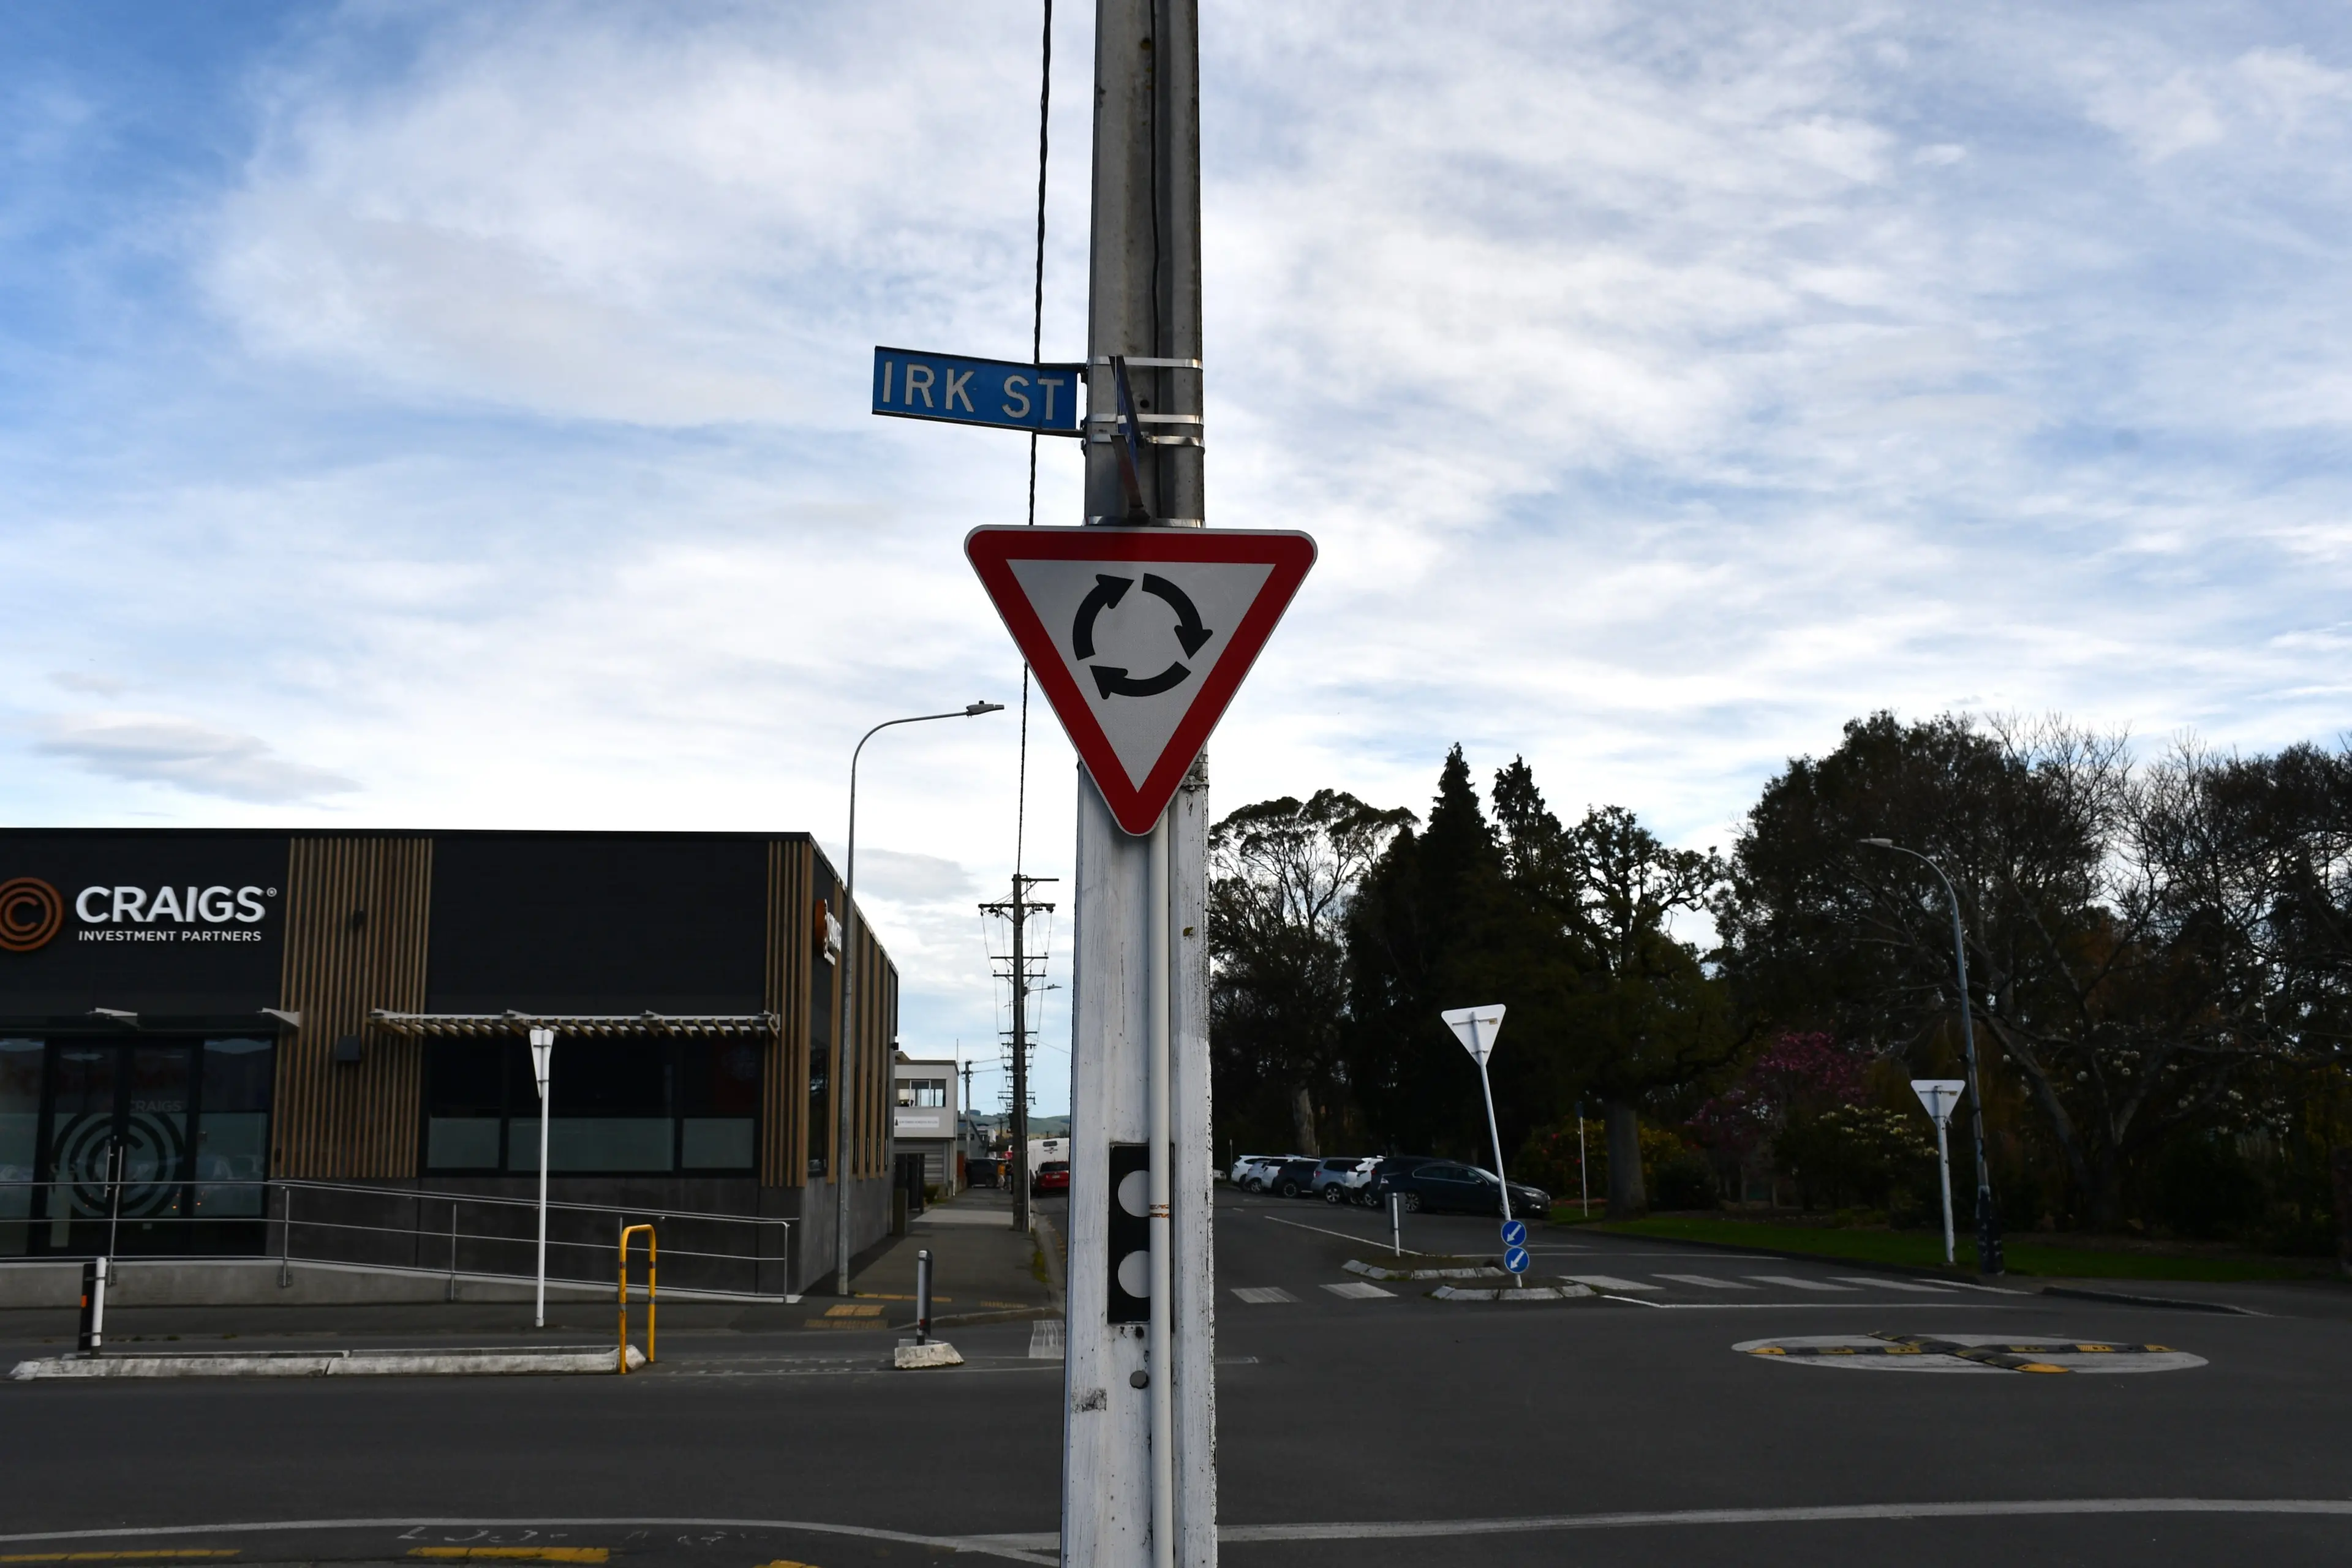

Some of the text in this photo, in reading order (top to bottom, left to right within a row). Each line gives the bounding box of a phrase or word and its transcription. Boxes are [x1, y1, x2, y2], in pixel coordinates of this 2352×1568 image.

[883, 361, 1065, 420] IRK ST
[78, 930, 262, 941] INVESTMENT PARTNERS
